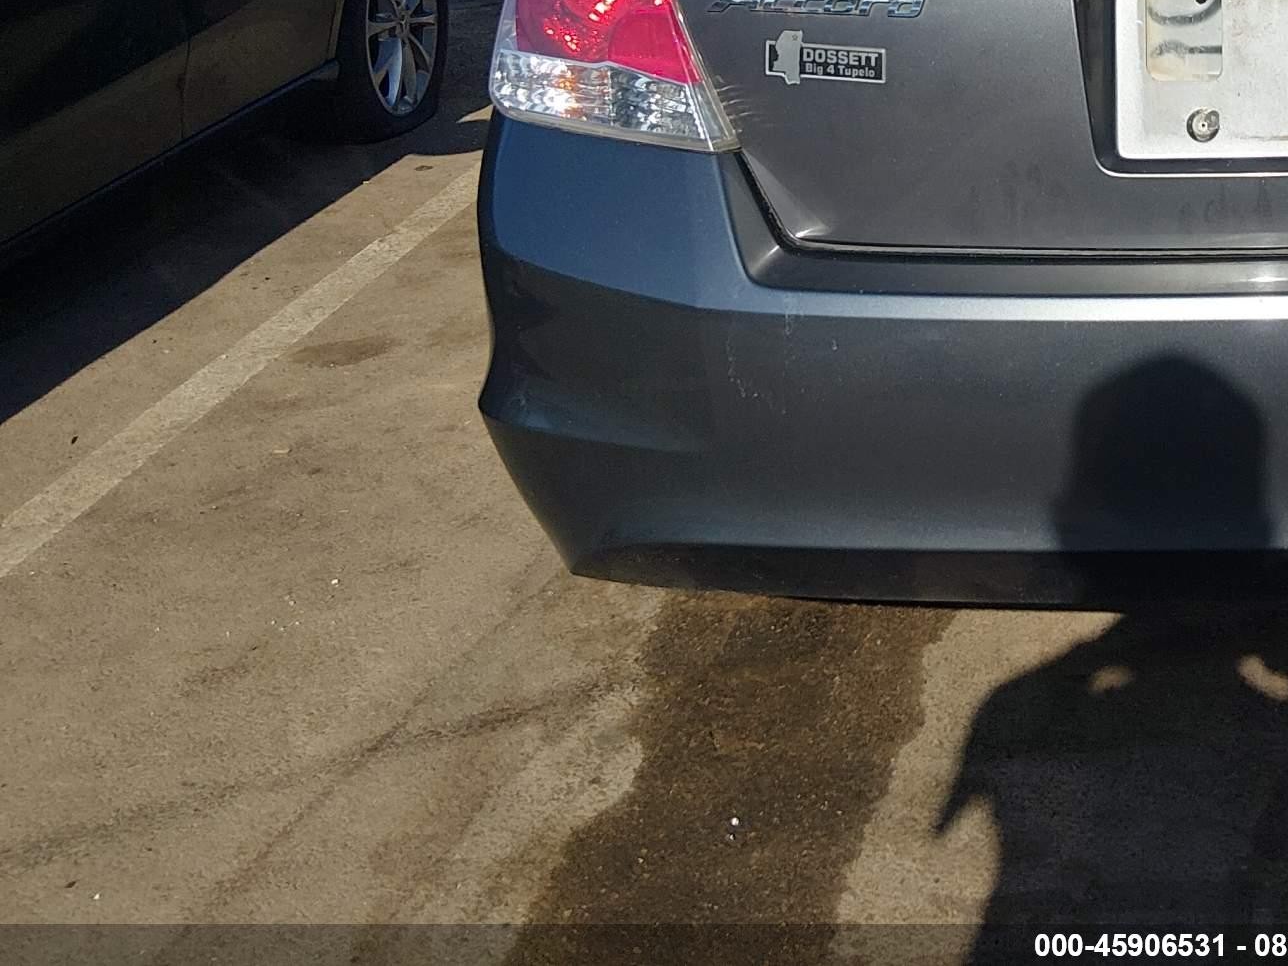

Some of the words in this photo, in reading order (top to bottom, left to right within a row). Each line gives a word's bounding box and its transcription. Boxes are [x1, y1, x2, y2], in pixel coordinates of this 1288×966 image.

[802, 48, 879, 67] DOSSETT
[805, 63, 824, 76] Big
[826, 65, 835, 75] 4
[838, 66, 876, 78] Tupelo
